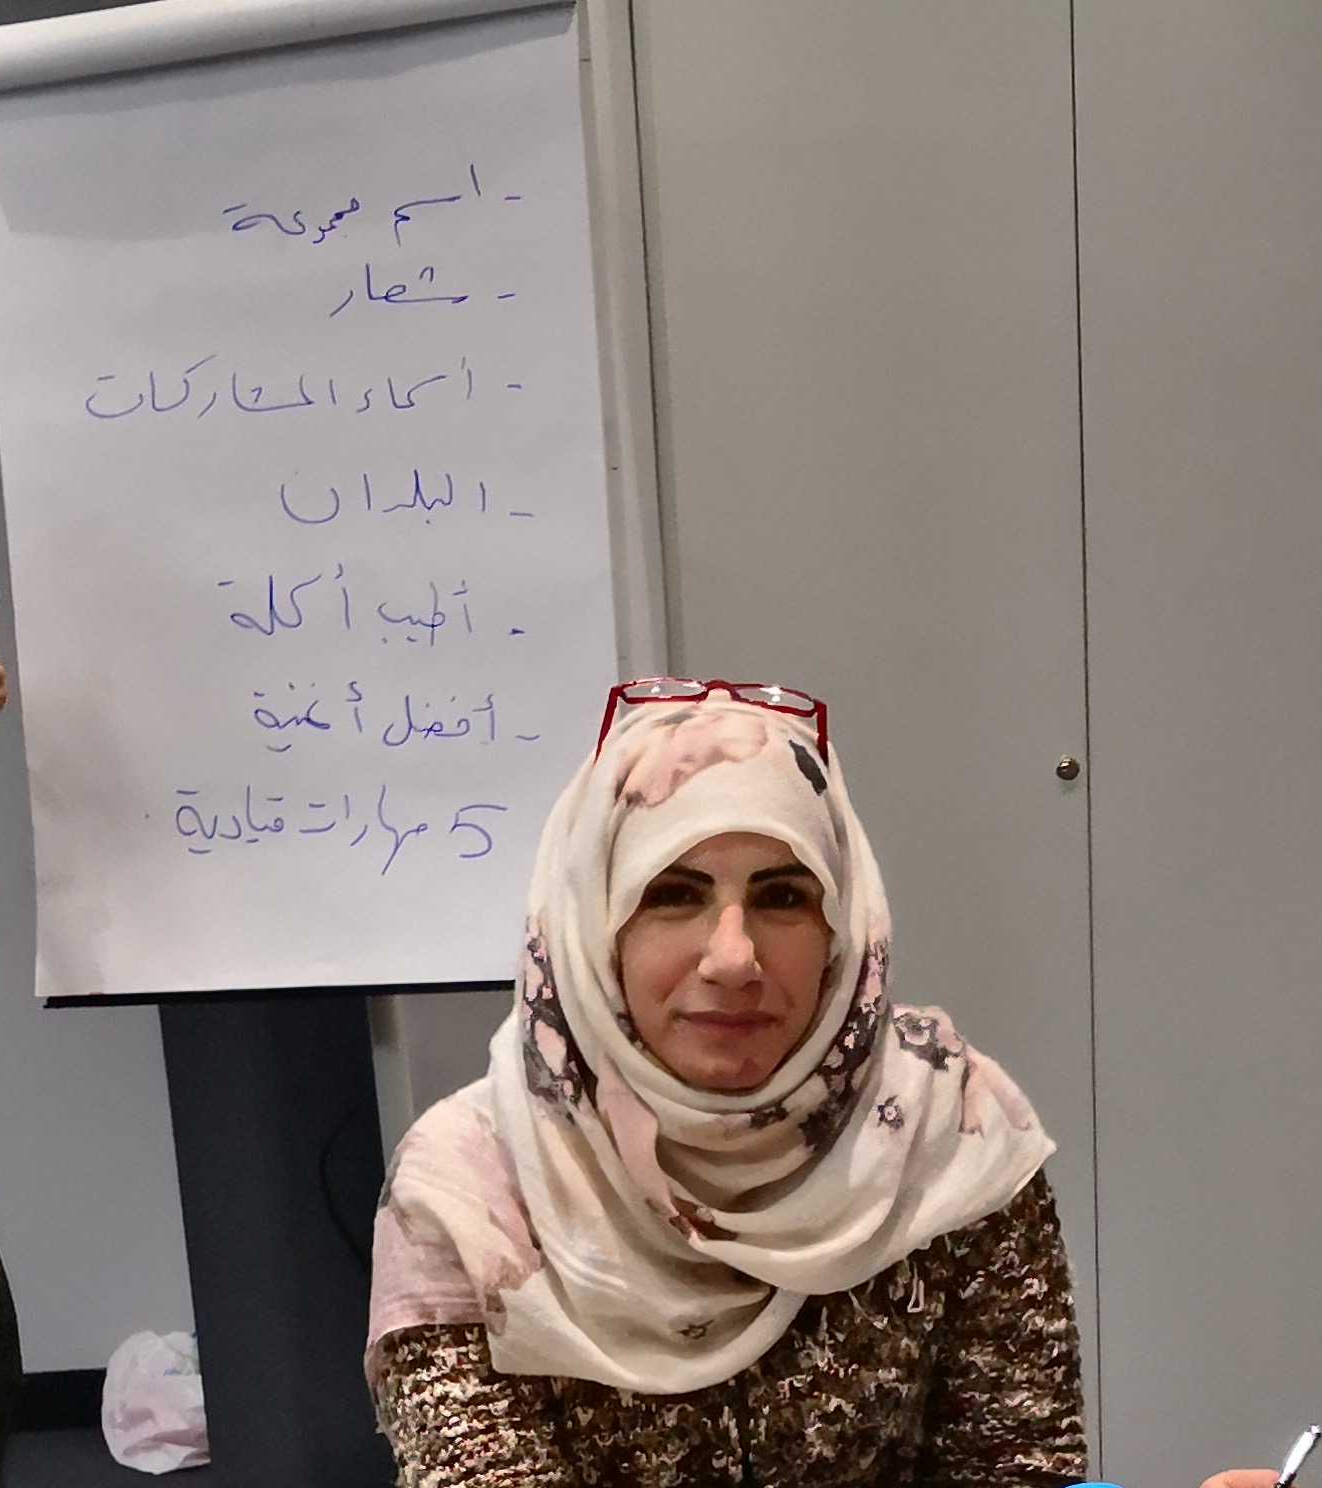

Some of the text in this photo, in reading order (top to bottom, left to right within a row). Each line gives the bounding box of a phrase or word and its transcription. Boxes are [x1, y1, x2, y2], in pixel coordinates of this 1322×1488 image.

[328, 262, 470, 319] شعار
[279, 468, 487, 525] البلدان
[216, 562, 351, 637] أكلة
[253, 680, 496, 754] أفضل أغنية
[298, 783, 429, 877] مهارات
